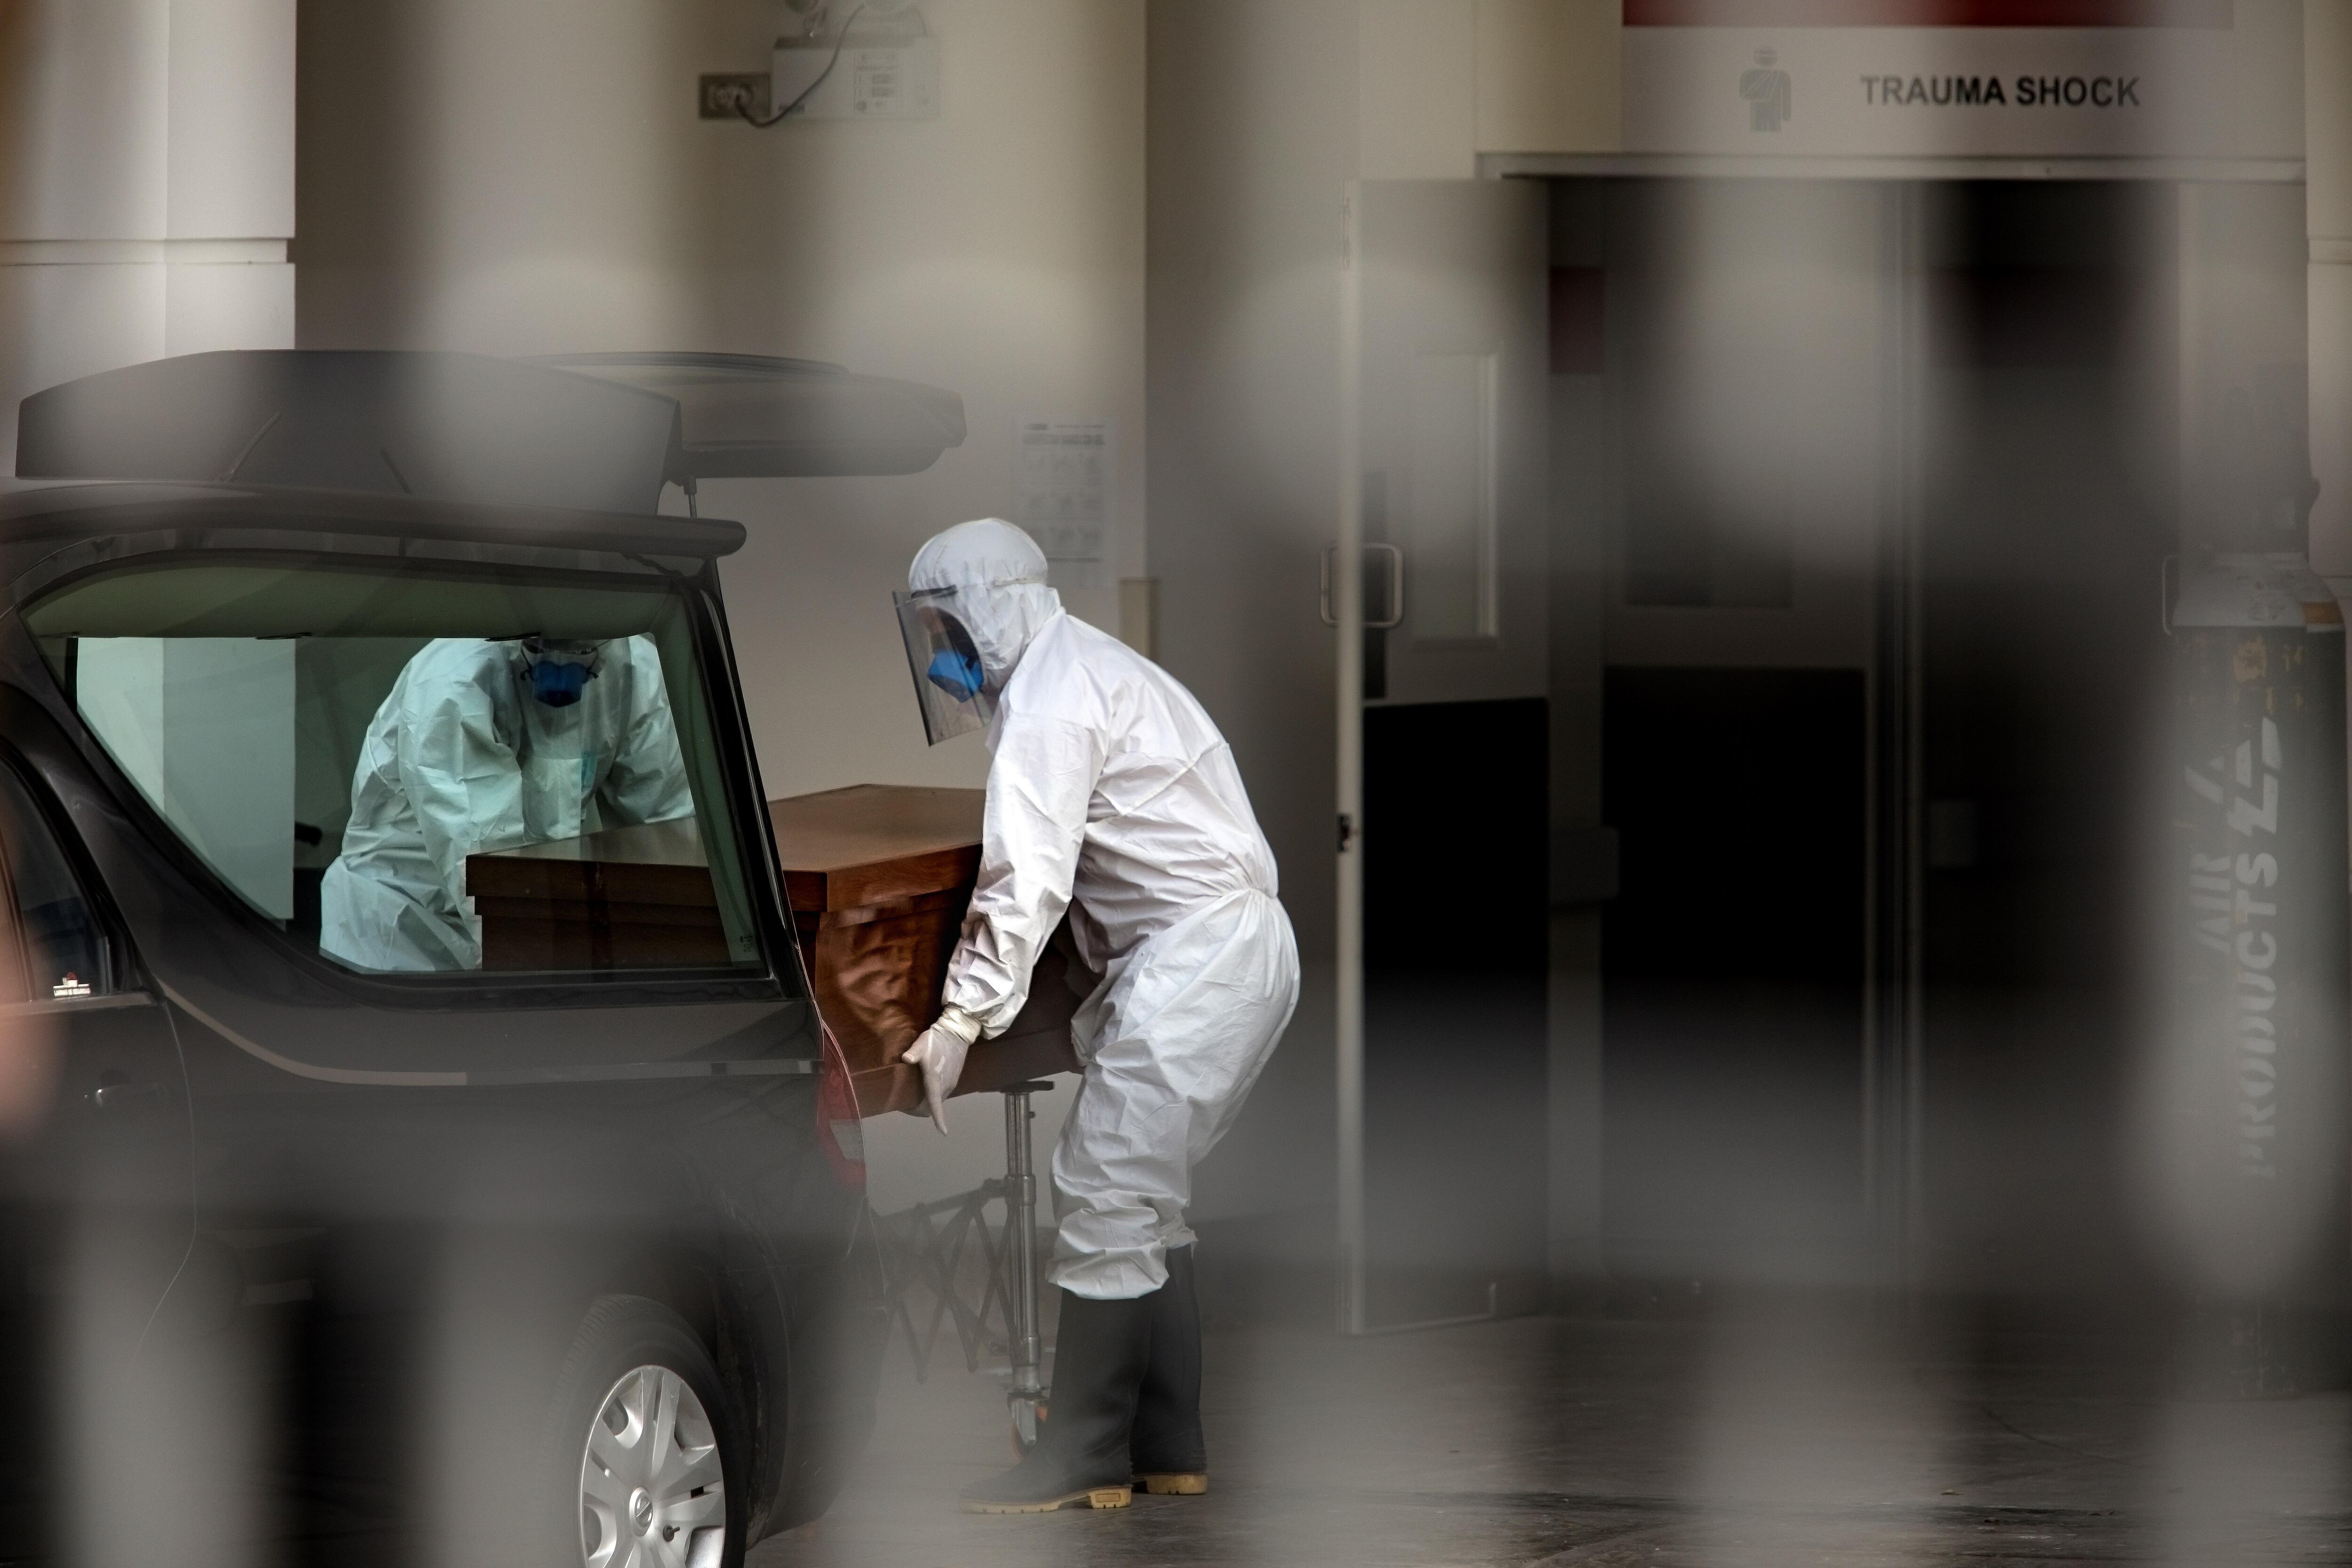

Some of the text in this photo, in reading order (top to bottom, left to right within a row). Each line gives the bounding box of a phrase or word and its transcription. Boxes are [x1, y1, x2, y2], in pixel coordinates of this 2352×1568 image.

[1860, 75, 2141, 107] TRAUMA SHOCK
[2189, 852, 2231, 954] AIR
[2234, 851, 2279, 1179] PRODUCTS
